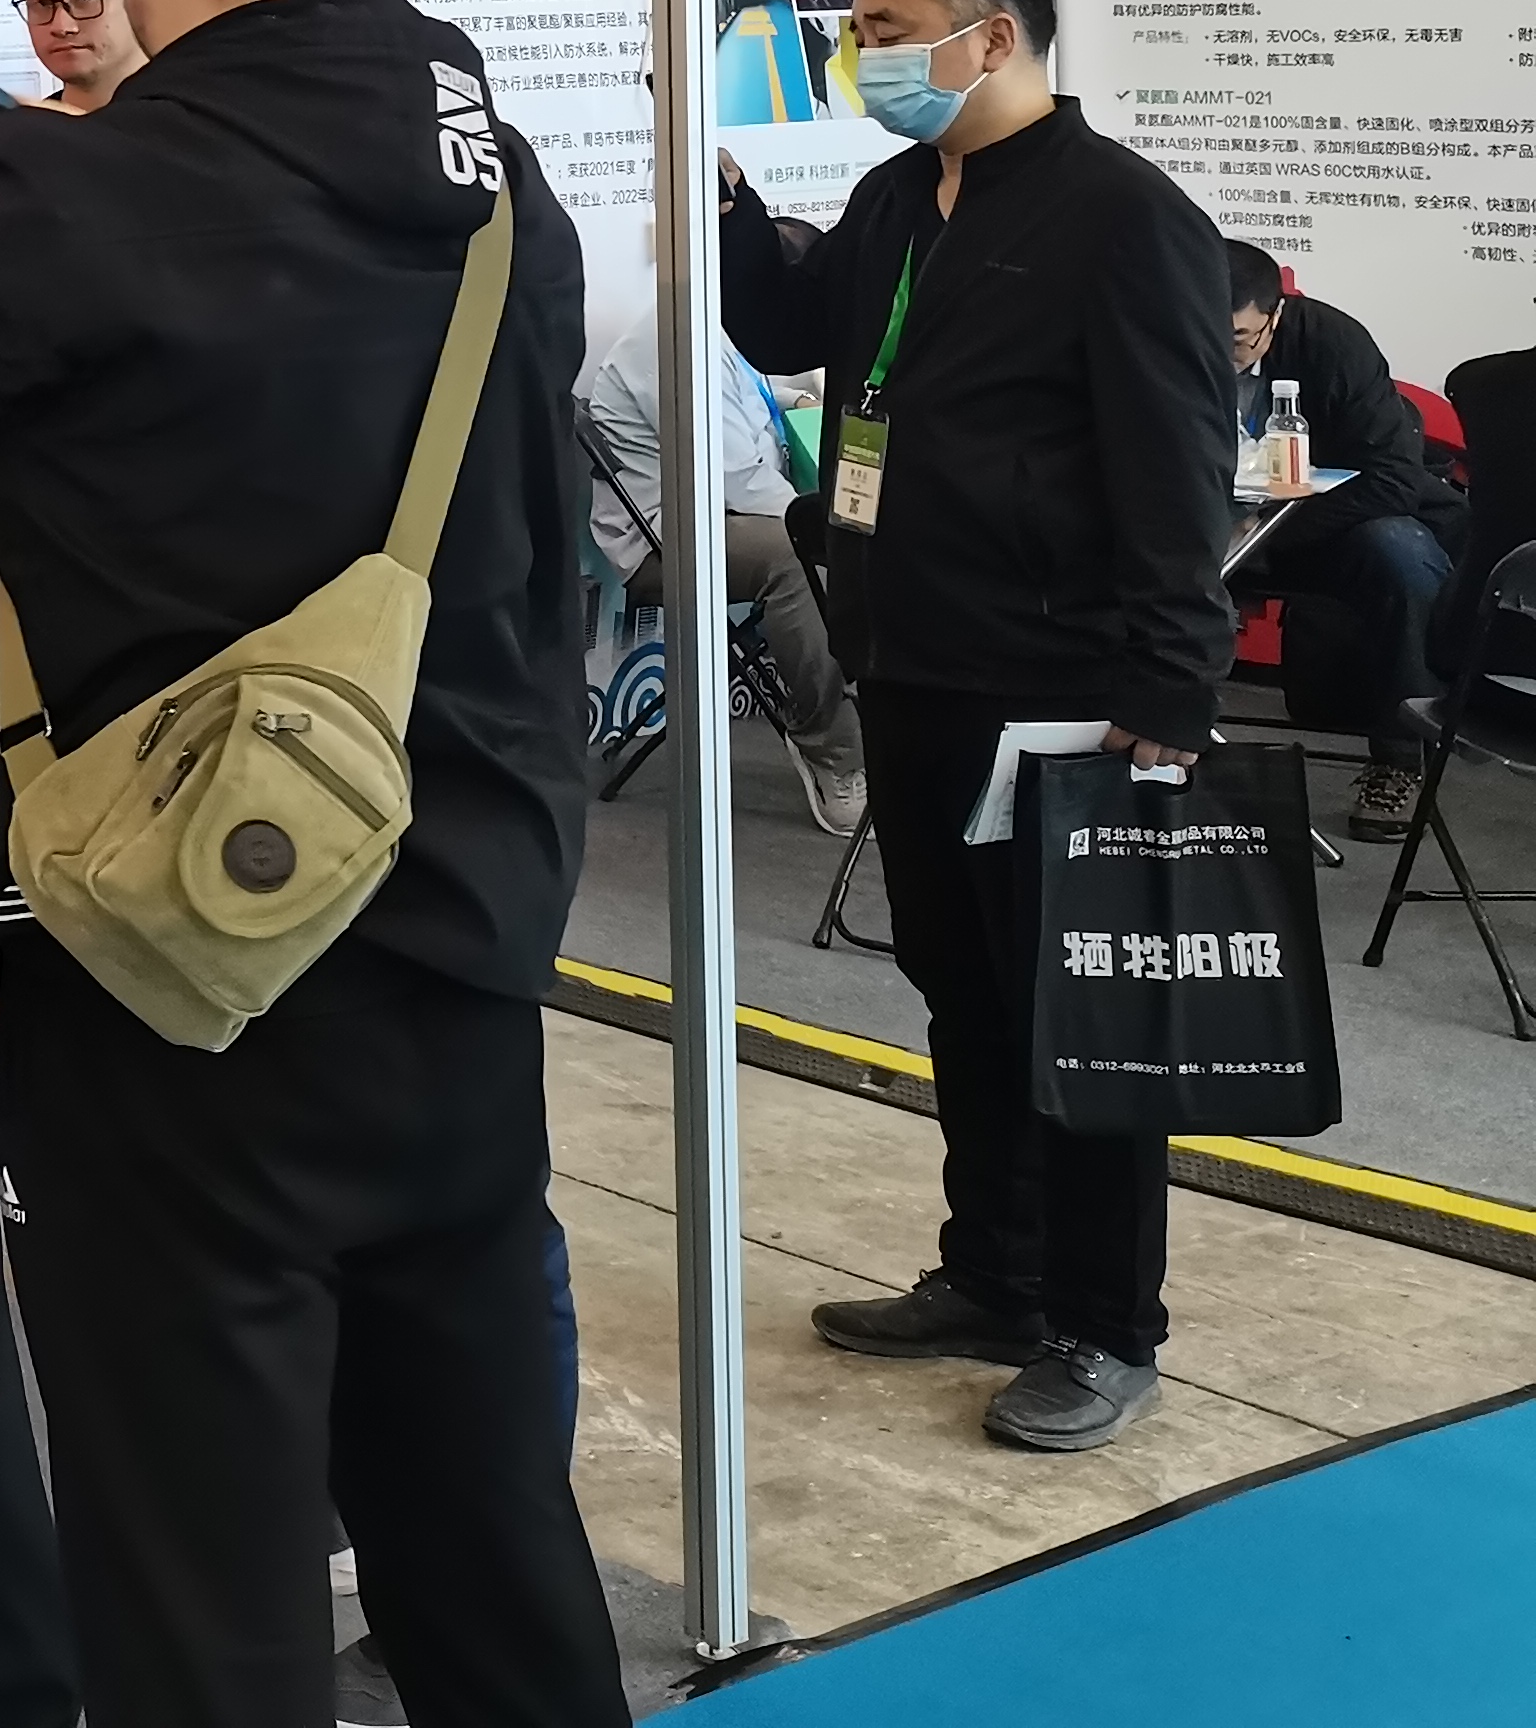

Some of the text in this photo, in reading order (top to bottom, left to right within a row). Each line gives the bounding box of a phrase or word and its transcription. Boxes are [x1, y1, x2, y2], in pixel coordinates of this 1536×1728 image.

[1136, 89, 1273, 106] 聚氨酯 AMMT-021
[438, 128, 504, 193] 05
[1275, 163, 1321, 177] WRAS
[1219, 212, 1313, 228] 优异的防腐性能
[1062, 931, 1284, 981] 牺牲阳极
